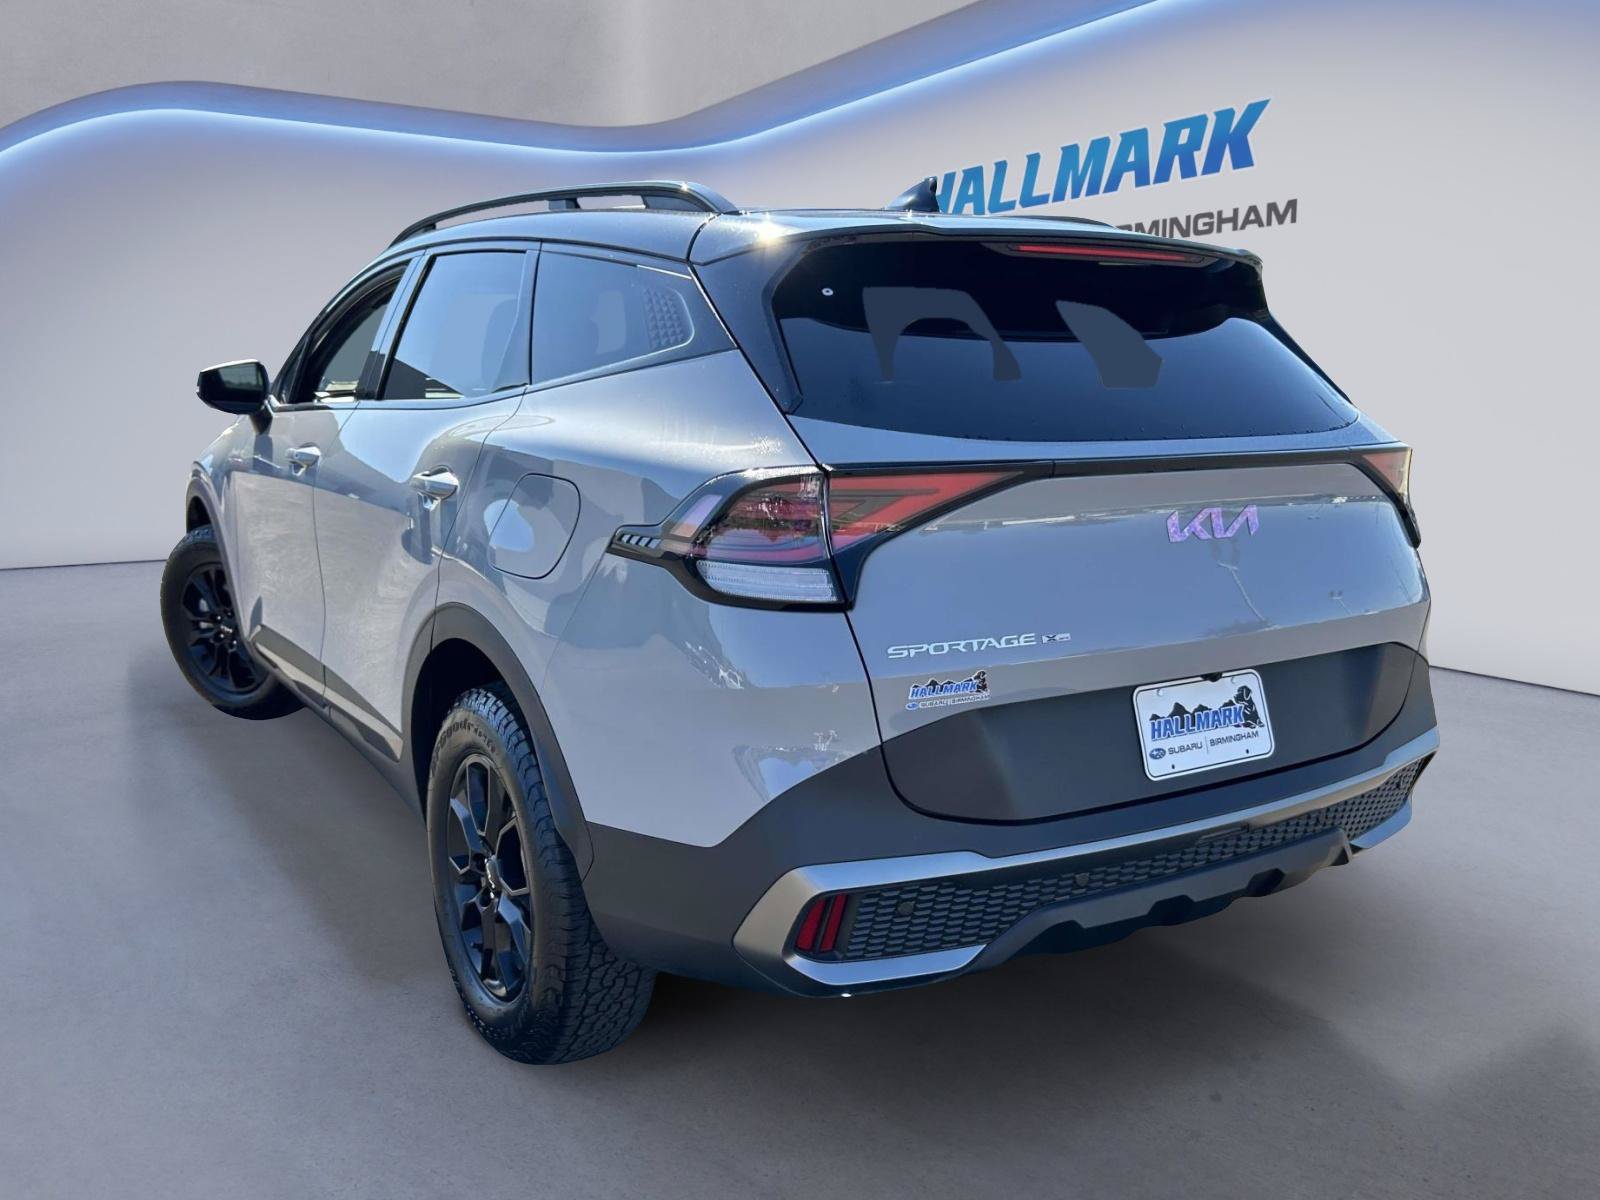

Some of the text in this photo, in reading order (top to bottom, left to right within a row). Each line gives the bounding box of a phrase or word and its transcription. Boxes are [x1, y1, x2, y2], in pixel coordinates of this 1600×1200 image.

[1117, 199, 1298, 239] MINGHAM
[1166, 504, 1260, 543] KIA
[887, 632, 1037, 659] SPORTAGE
[910, 680, 977, 699] HALLMARK
[1150, 705, 1245, 741] HALLMARK
[1167, 730, 1260, 756] SUBARU BIRMINGHAM
